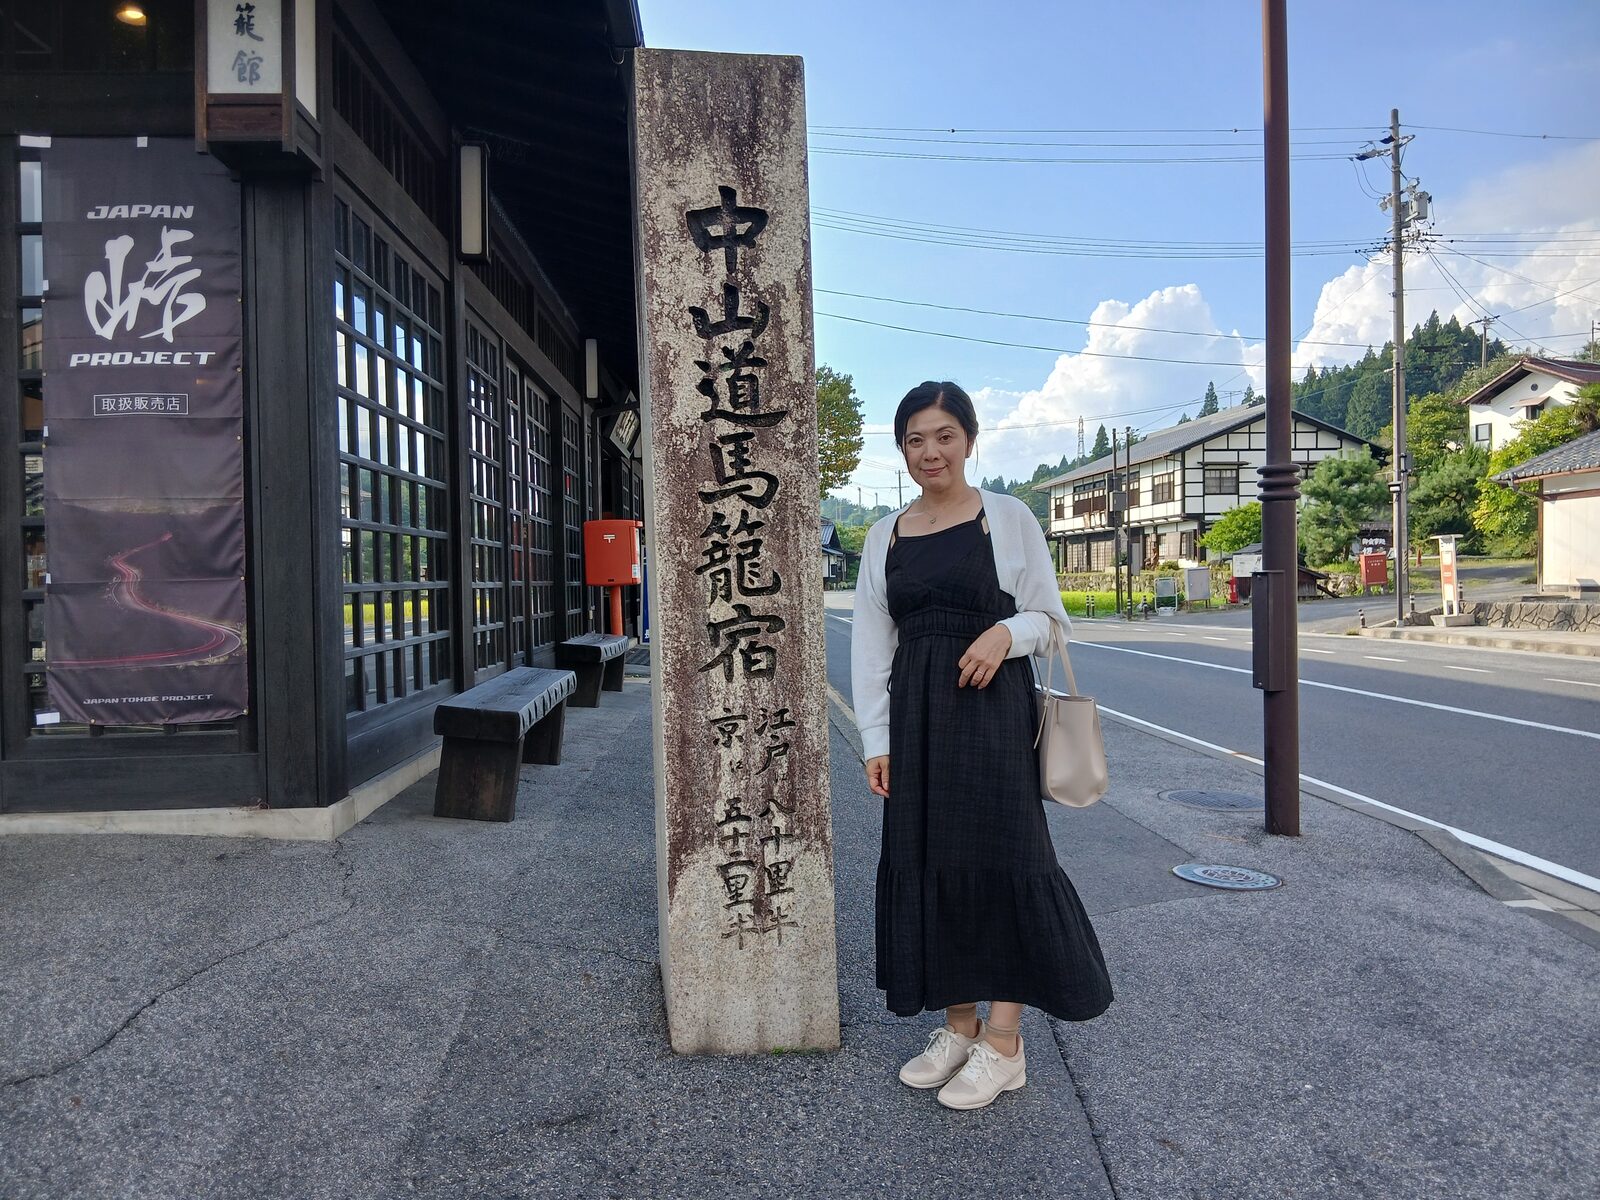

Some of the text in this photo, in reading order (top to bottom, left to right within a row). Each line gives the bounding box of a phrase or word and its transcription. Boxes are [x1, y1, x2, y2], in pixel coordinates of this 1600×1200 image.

[86, 204, 195, 220] JAPAN
[84, 225, 207, 343] 峠
[69, 351, 216, 367] PROJECT
[101, 396, 181, 412] 取扱販売店
[685, 184, 788, 683] 中山道馬籠宿
[83, 693, 214, 705] JAPAN TOHGE PROJECT
